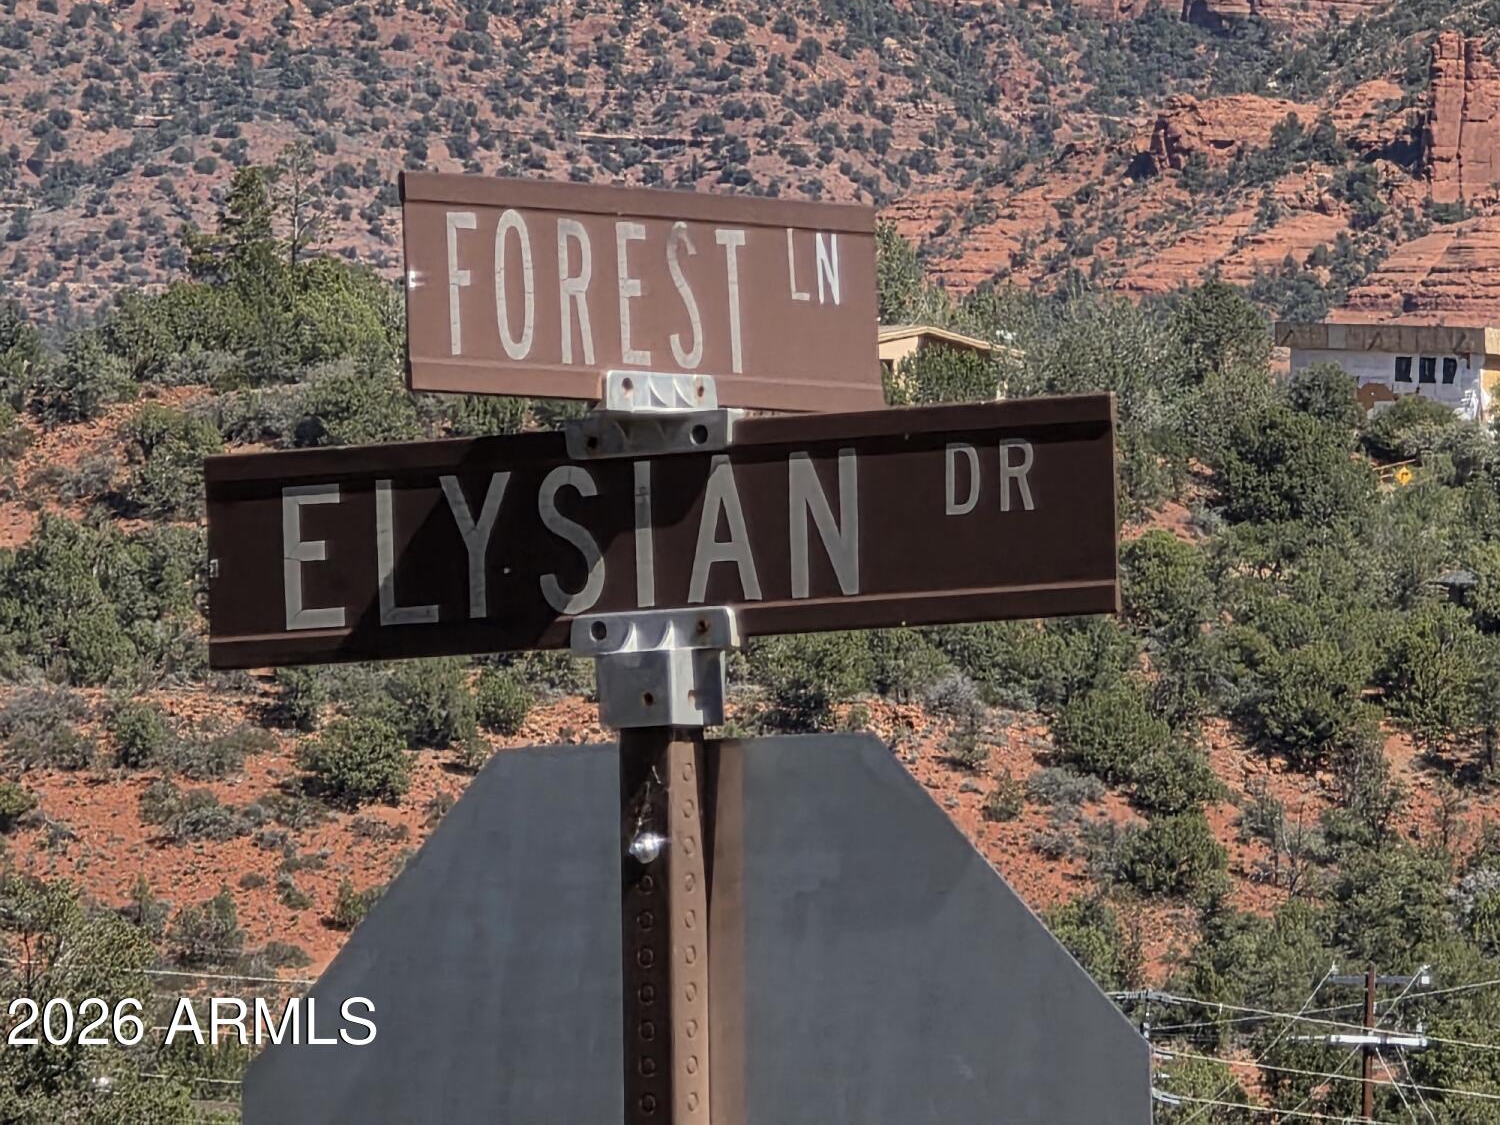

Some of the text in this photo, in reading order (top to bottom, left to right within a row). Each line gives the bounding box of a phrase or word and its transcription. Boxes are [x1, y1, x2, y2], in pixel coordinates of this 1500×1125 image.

[445, 208, 841, 374] FOREST LN
[281, 437, 1036, 631] ELYSIAN DR
